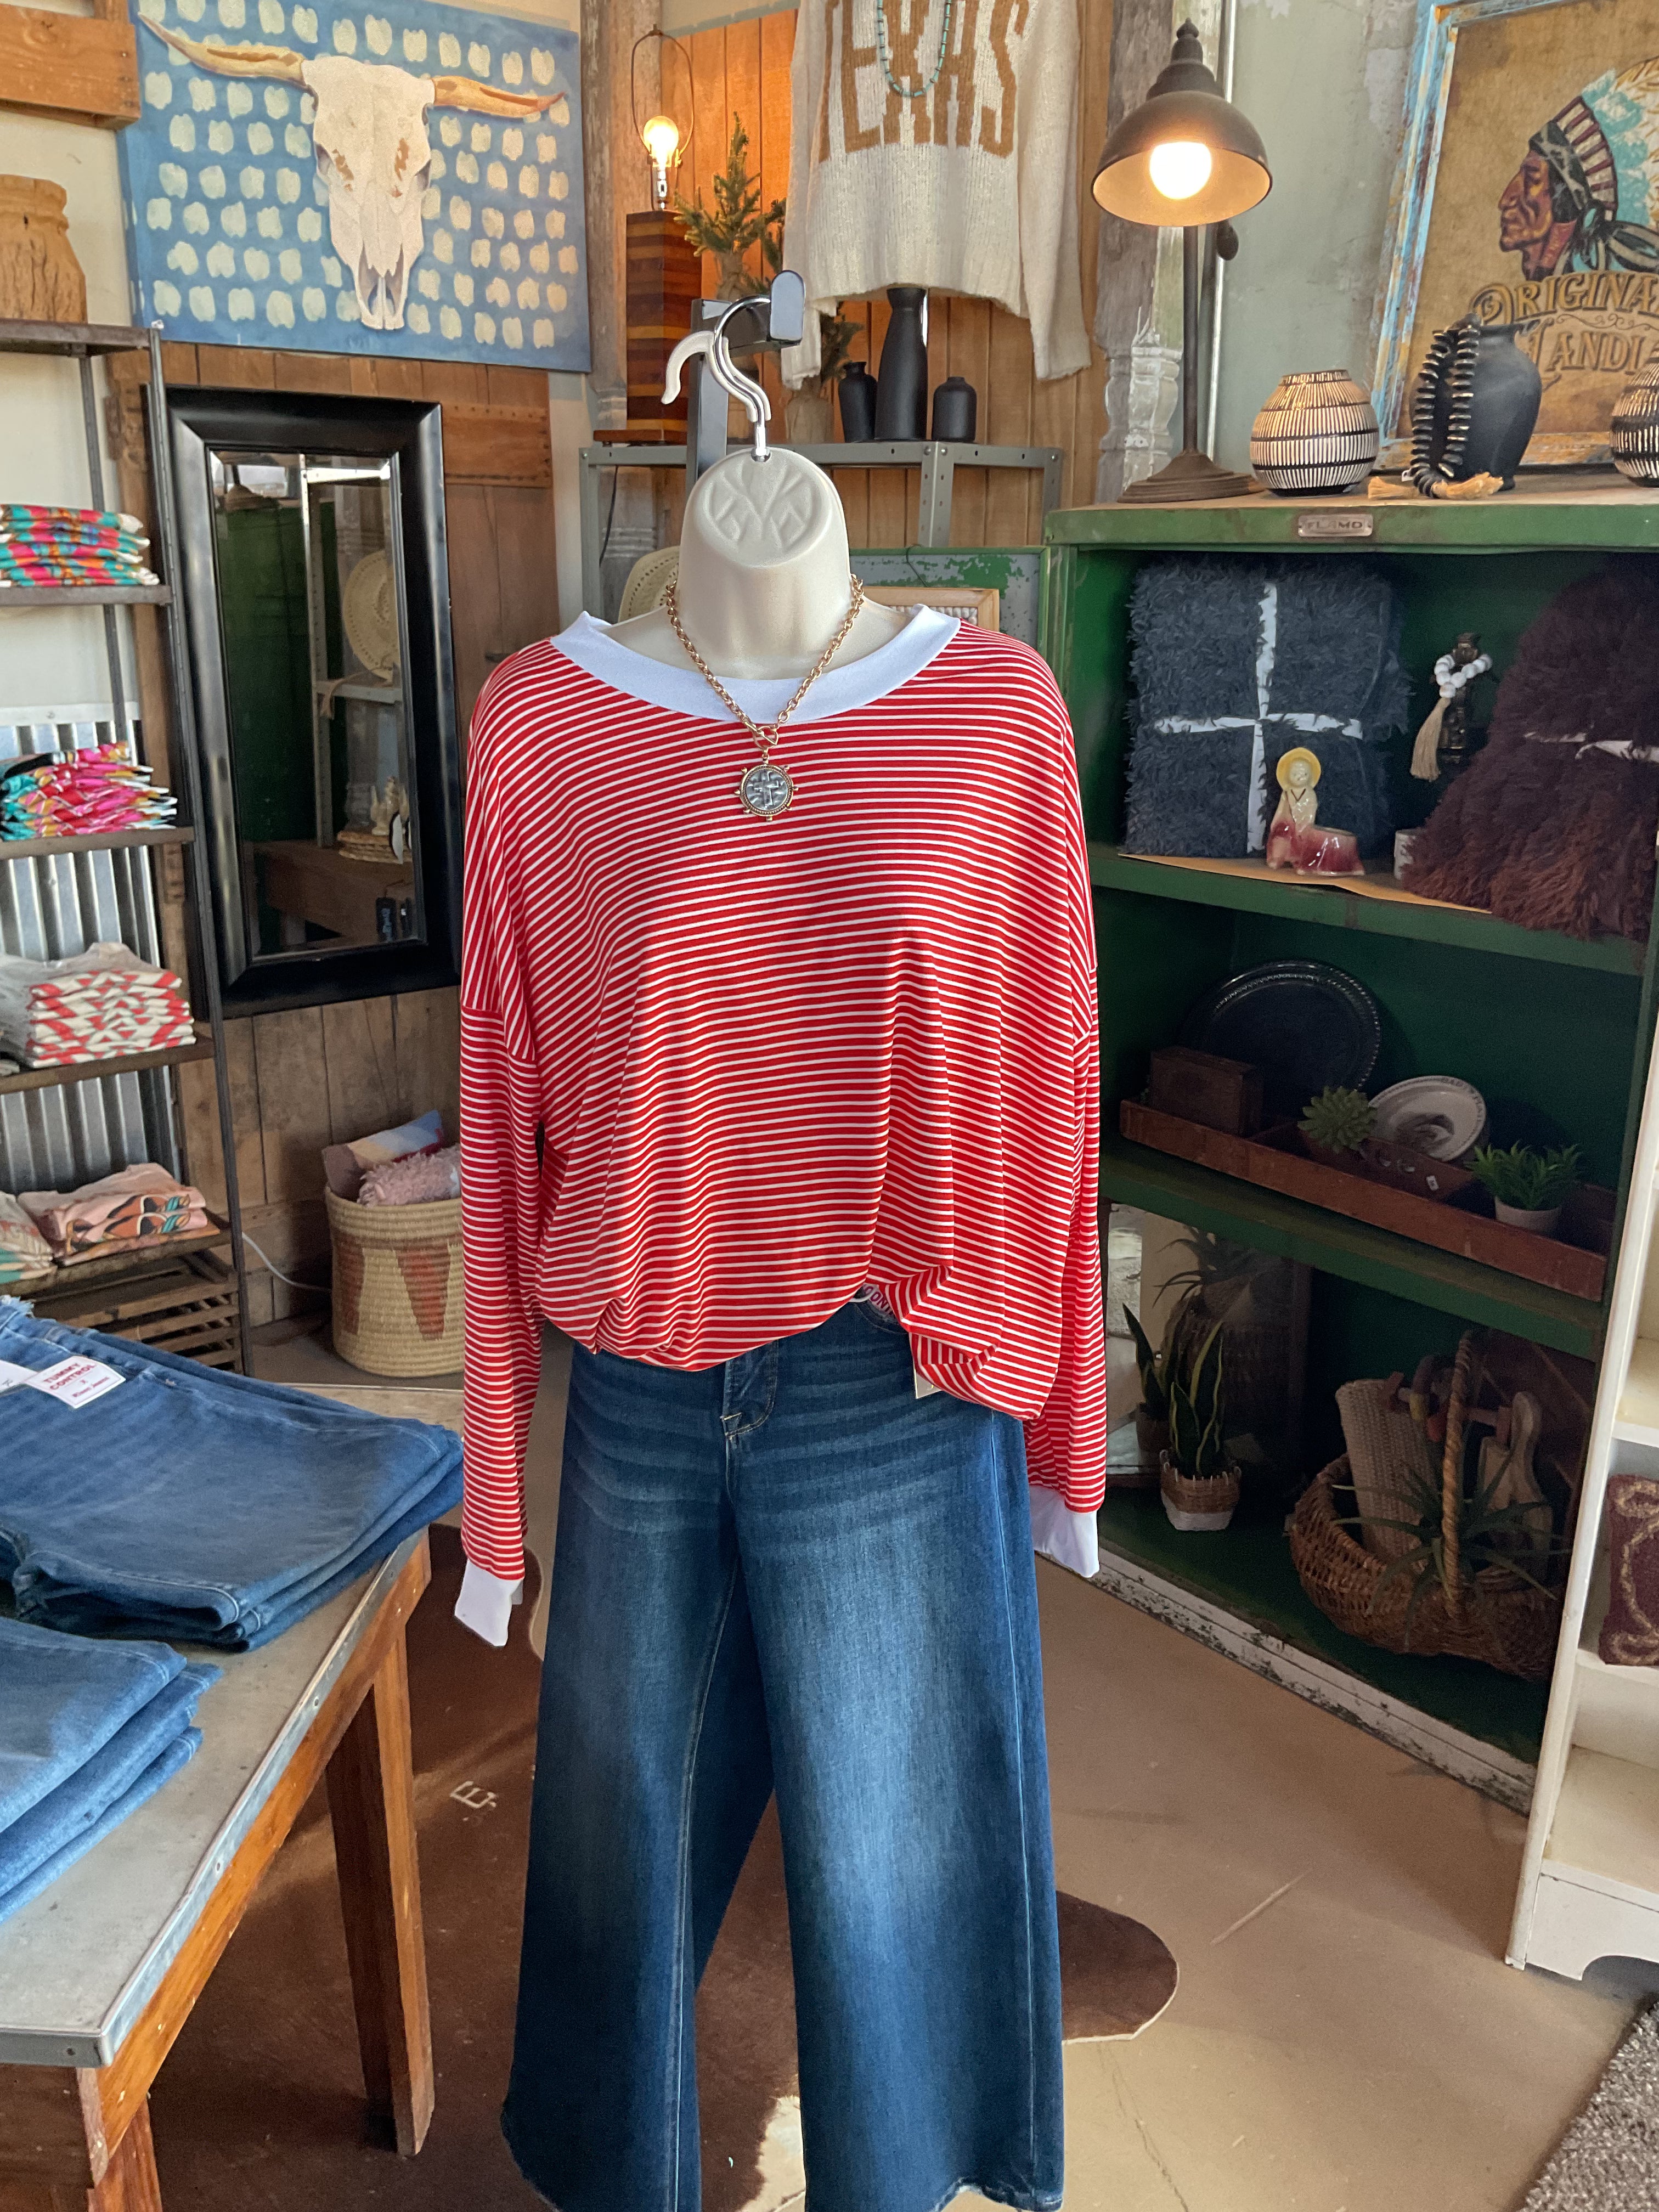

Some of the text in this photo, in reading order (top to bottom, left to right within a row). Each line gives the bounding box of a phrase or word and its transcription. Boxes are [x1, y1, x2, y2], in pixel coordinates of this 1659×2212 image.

[1470, 272, 1659, 324] ORIGINA
[43, 1363, 81, 1383] TUMMY
[50, 1364, 97, 1390] CONTROL
